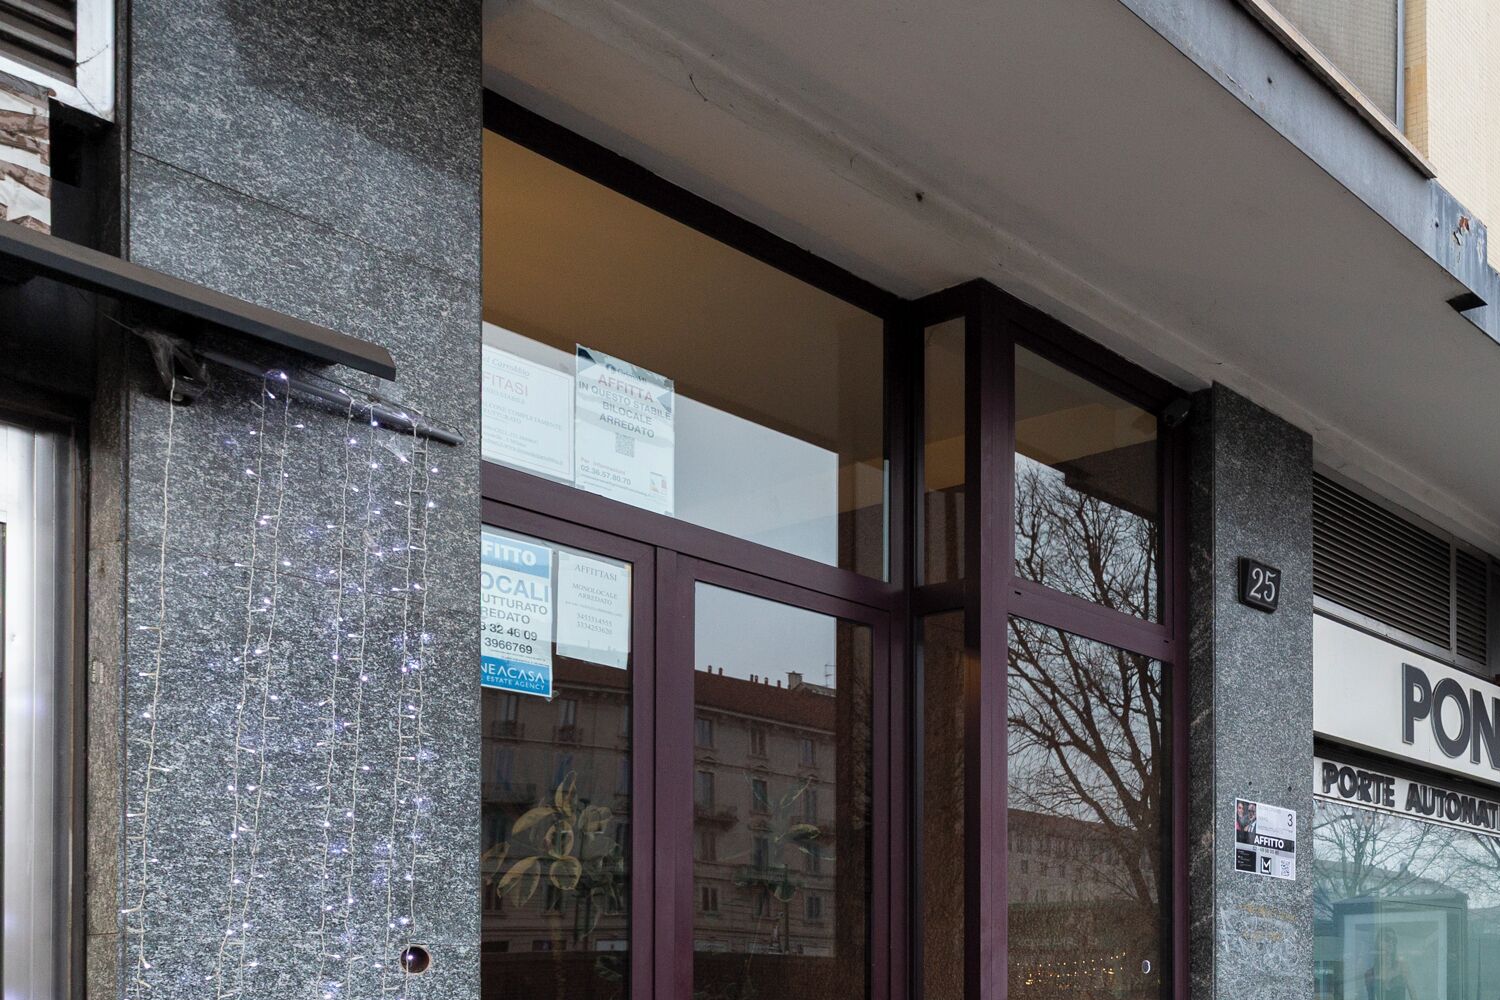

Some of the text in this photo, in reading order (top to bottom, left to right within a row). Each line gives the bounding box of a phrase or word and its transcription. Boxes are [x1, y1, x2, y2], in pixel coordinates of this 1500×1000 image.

[599, 374, 653, 402] AFFITTA
[579, 381, 671, 421] IN QUESTO STABILE
[600, 413, 655, 439] ARREDATO
[603, 402, 652, 426] BILOCALE
[575, 564, 618, 582] AFFITTASI
[1250, 568, 1276, 602] 25
[489, 623, 504, 635] 32
[507, 627, 521, 638] 46
[523, 630, 538, 642] 09
[485, 637, 533, 655] 3966769
[486, 676, 545, 692] ESTATE AGENCY
[1322, 762, 1396, 808] PORTE
[1254, 835, 1284, 849] AFFITTO
